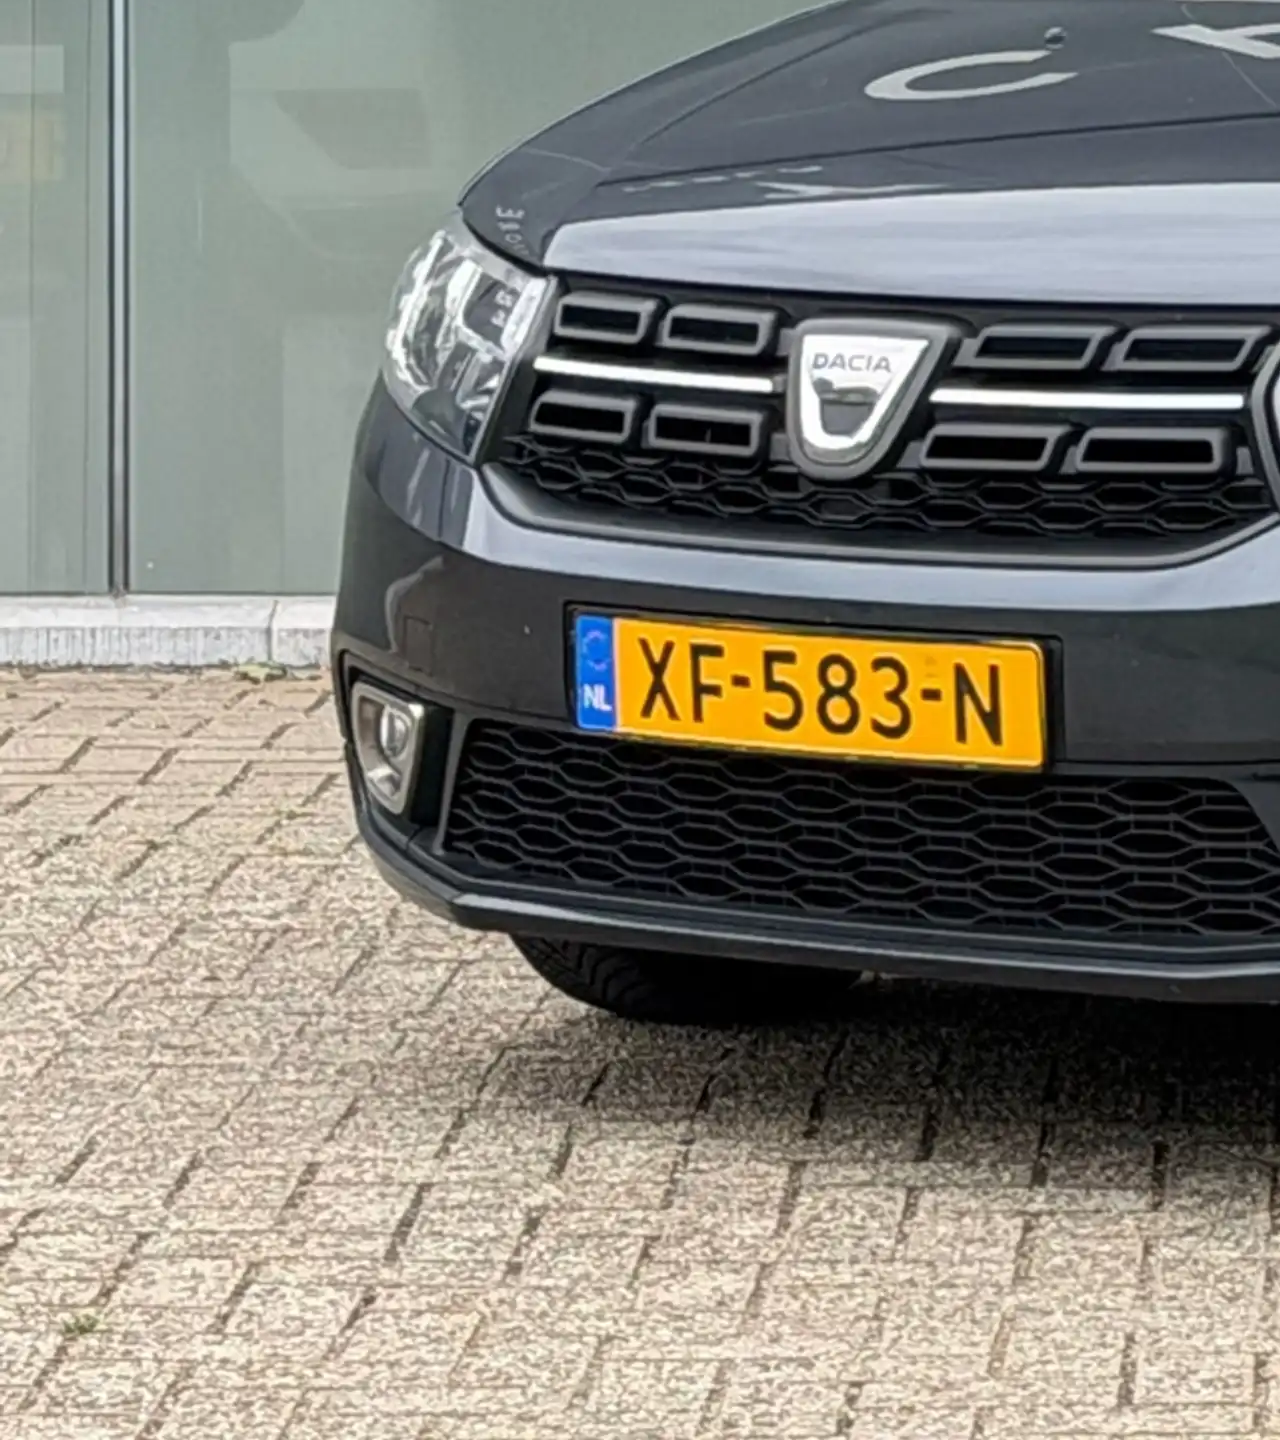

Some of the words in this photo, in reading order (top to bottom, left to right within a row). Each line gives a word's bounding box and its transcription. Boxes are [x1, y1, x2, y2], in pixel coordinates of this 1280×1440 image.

[811, 352, 893, 373] DACIA
[582, 684, 612, 713] NL
[636, 636, 1004, 748] XF-583-N
